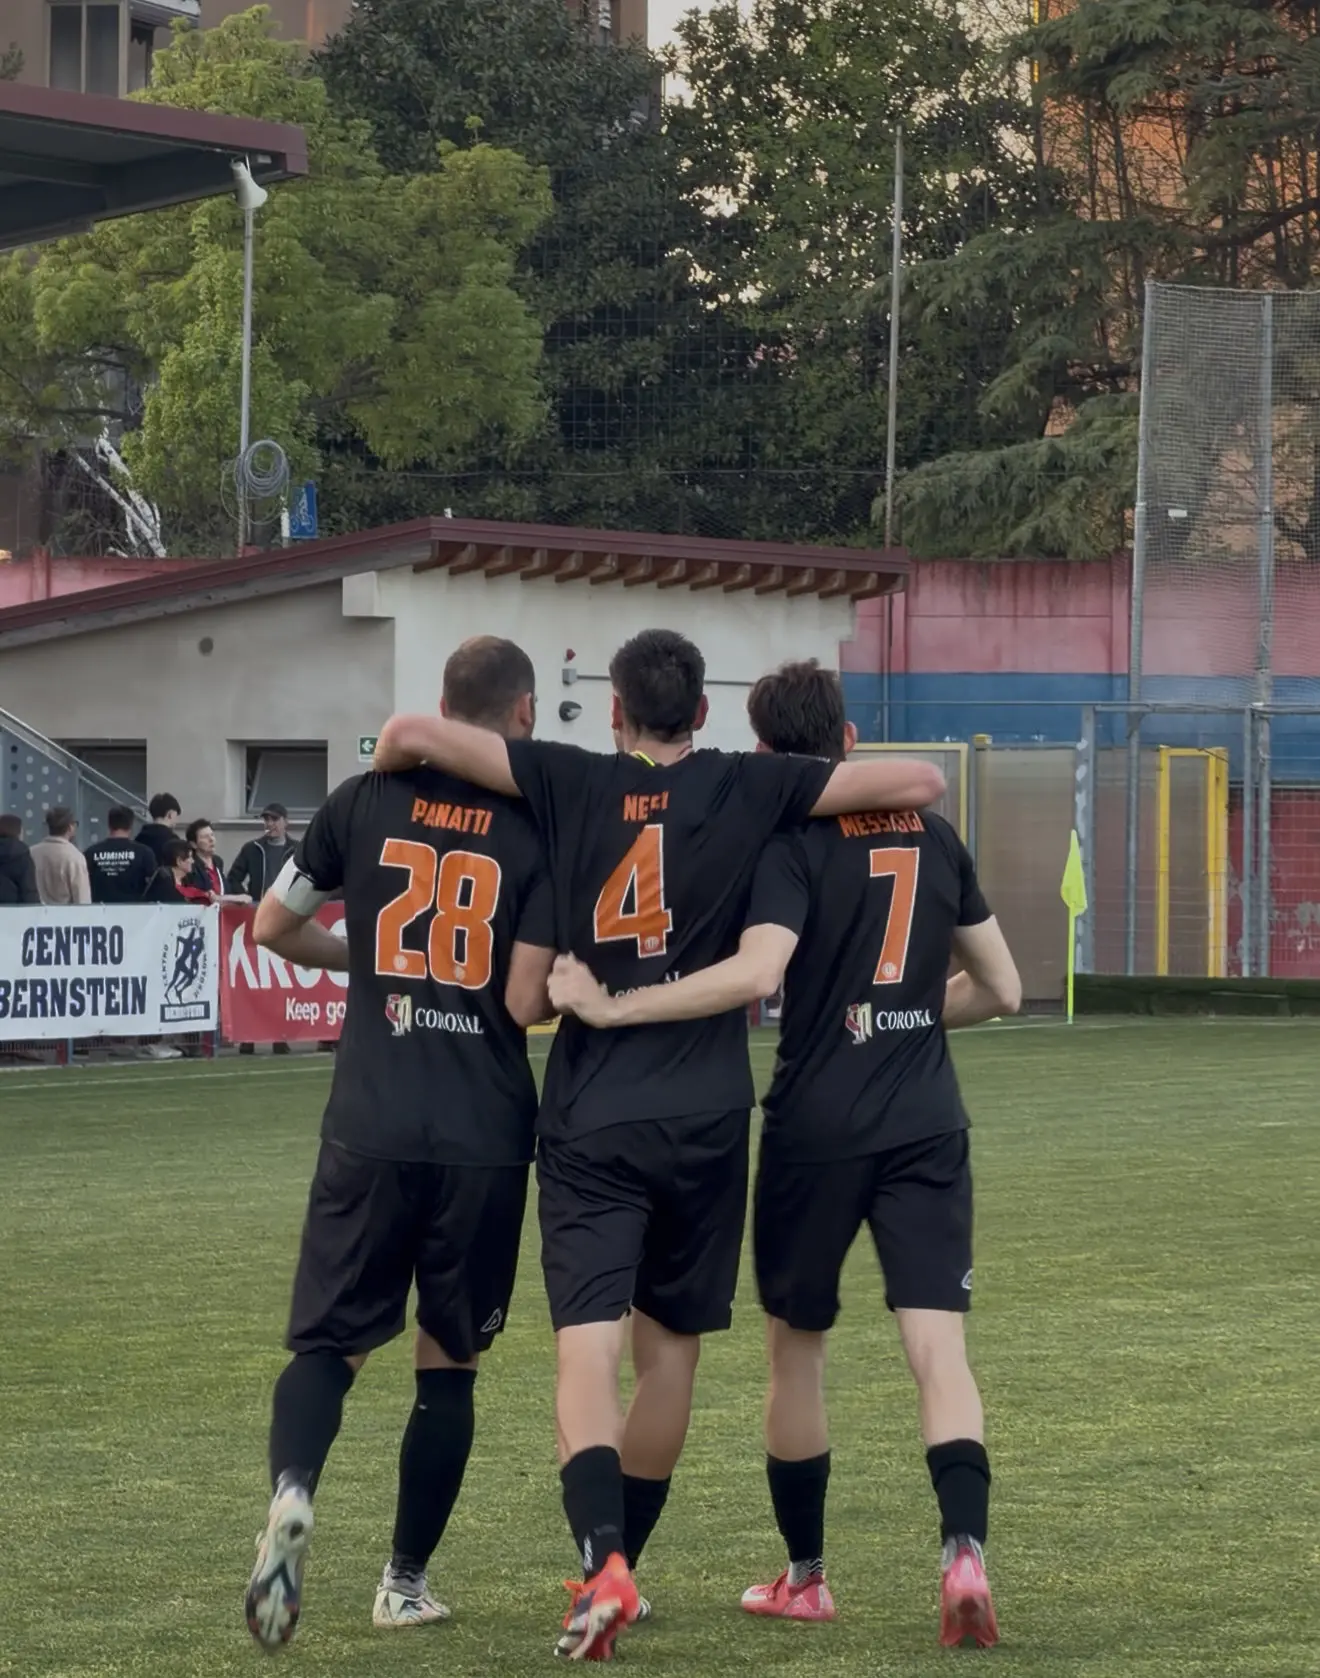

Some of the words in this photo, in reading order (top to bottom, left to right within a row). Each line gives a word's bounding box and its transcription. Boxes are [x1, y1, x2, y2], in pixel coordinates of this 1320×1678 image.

[411, 798, 492, 836] PANATTI
[593, 824, 672, 959] 4
[376, 838, 501, 990] 28
[869, 847, 920, 985] 7
[22, 925, 123, 967] CENTRO
[0, 976, 147, 1018] BERNSTEIN
[286, 998, 320, 1026] Keep
